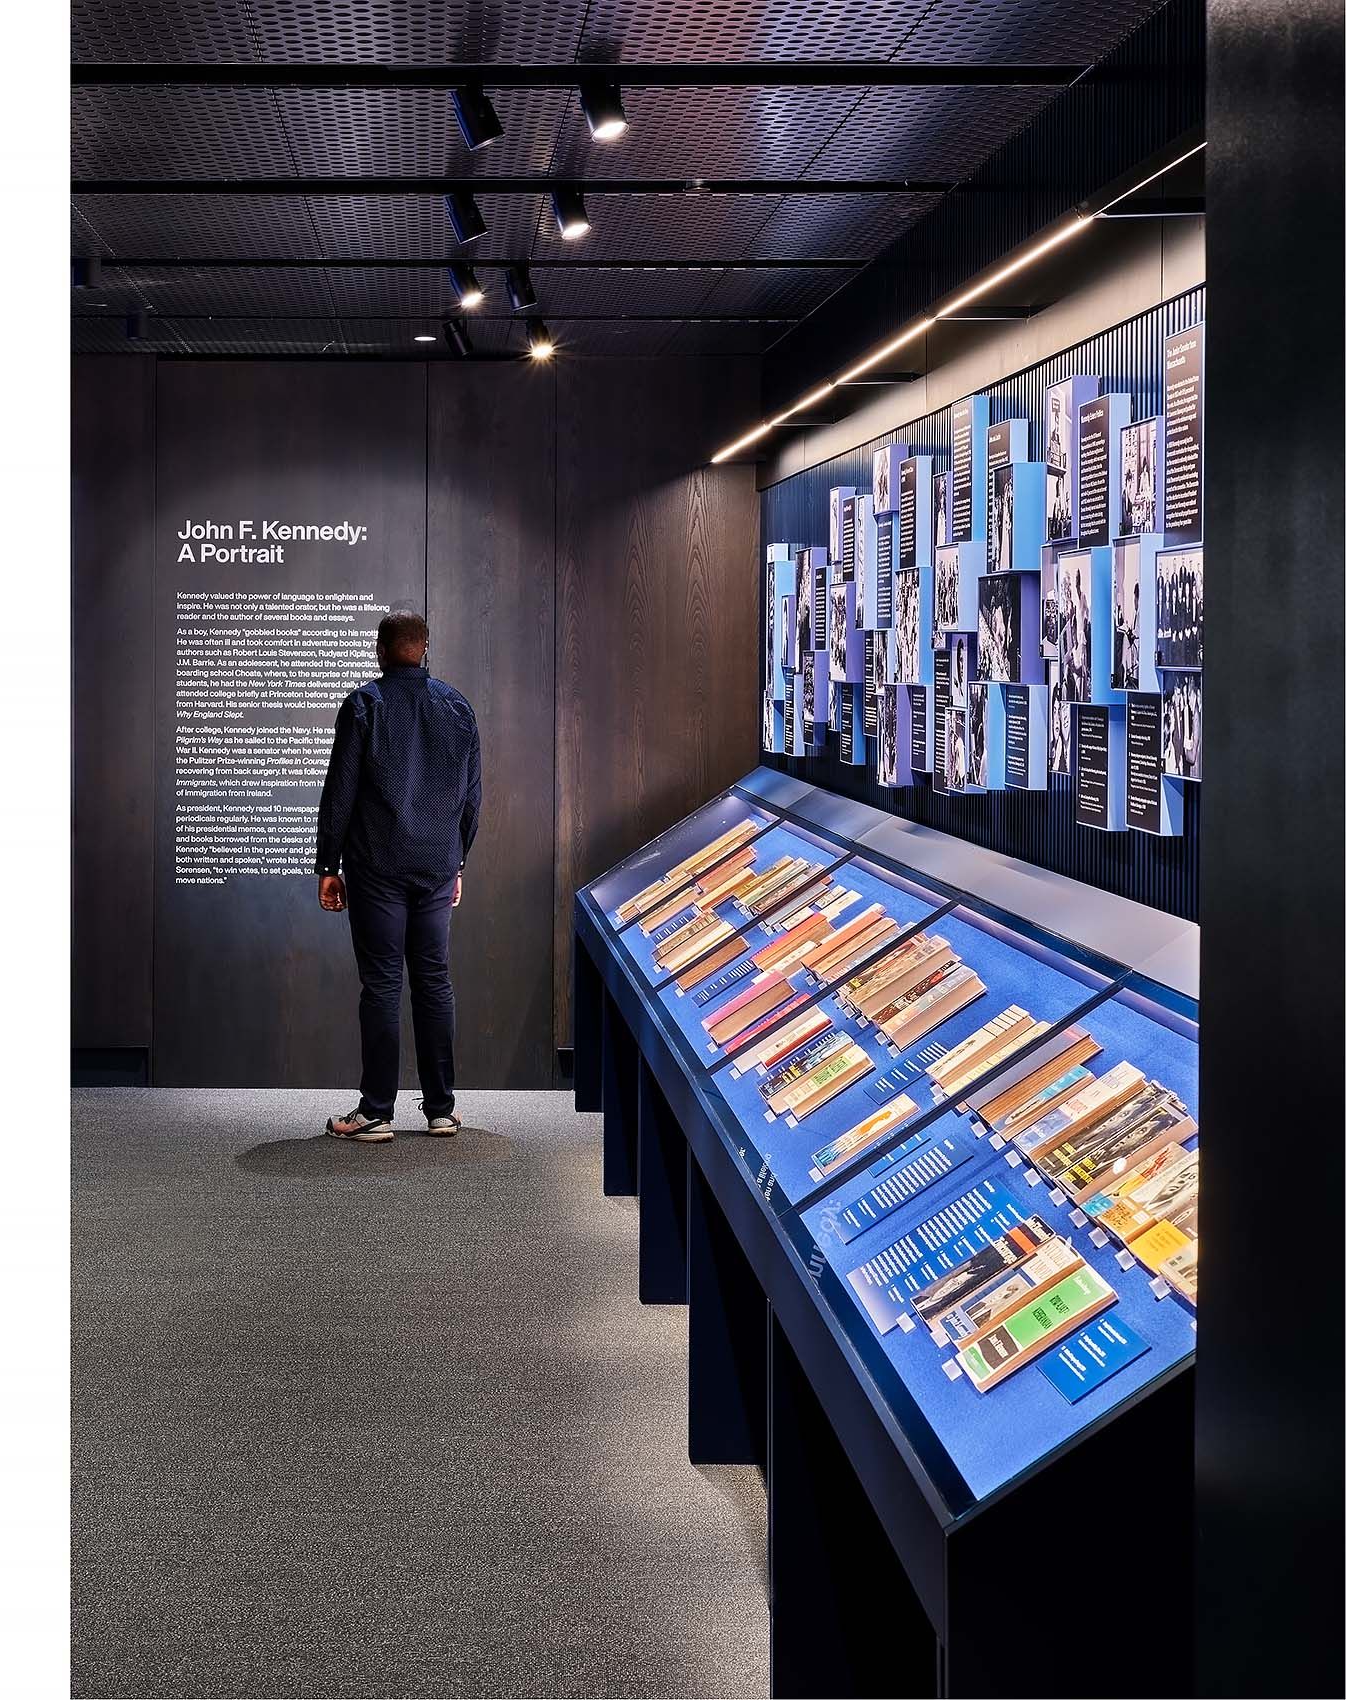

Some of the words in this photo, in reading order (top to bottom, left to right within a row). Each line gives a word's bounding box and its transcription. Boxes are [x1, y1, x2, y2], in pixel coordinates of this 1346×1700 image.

[177, 520, 233, 540] John
[239, 521, 257, 540] F.
[262, 520, 367, 545] Kennedy:
[177, 544, 196, 563] A
[200, 544, 284, 563] Portrait
[176, 592, 209, 601] Kennedy
[209, 592, 234, 600] valued
[235, 592, 247, 600] the
[248, 593, 272, 601] power
[272, 592, 281, 600] of
[281, 593, 315, 602] language
[325, 593, 359, 602] enlighten
[176, 602, 202, 611] inspire.
[203, 602, 214, 610] He
[243, 602, 258, 612] only
[265, 603, 294, 611] talented
[295, 603, 318, 612] orator,
[318, 603, 331, 611] but
[331, 603, 341, 611] he
[363, 603, 390, 613] lifelong
[263, 613, 289, 621] several
[290, 613, 312, 621] books
[328, 614, 355, 622] essays.
[176, 710, 193, 719] Why
[193, 710, 224, 719] England
[223, 711, 244, 719] Slept.
[184, 789, 227, 798] immigration
[228, 789, 245, 797] from
[246, 789, 273, 797] Ireland.
